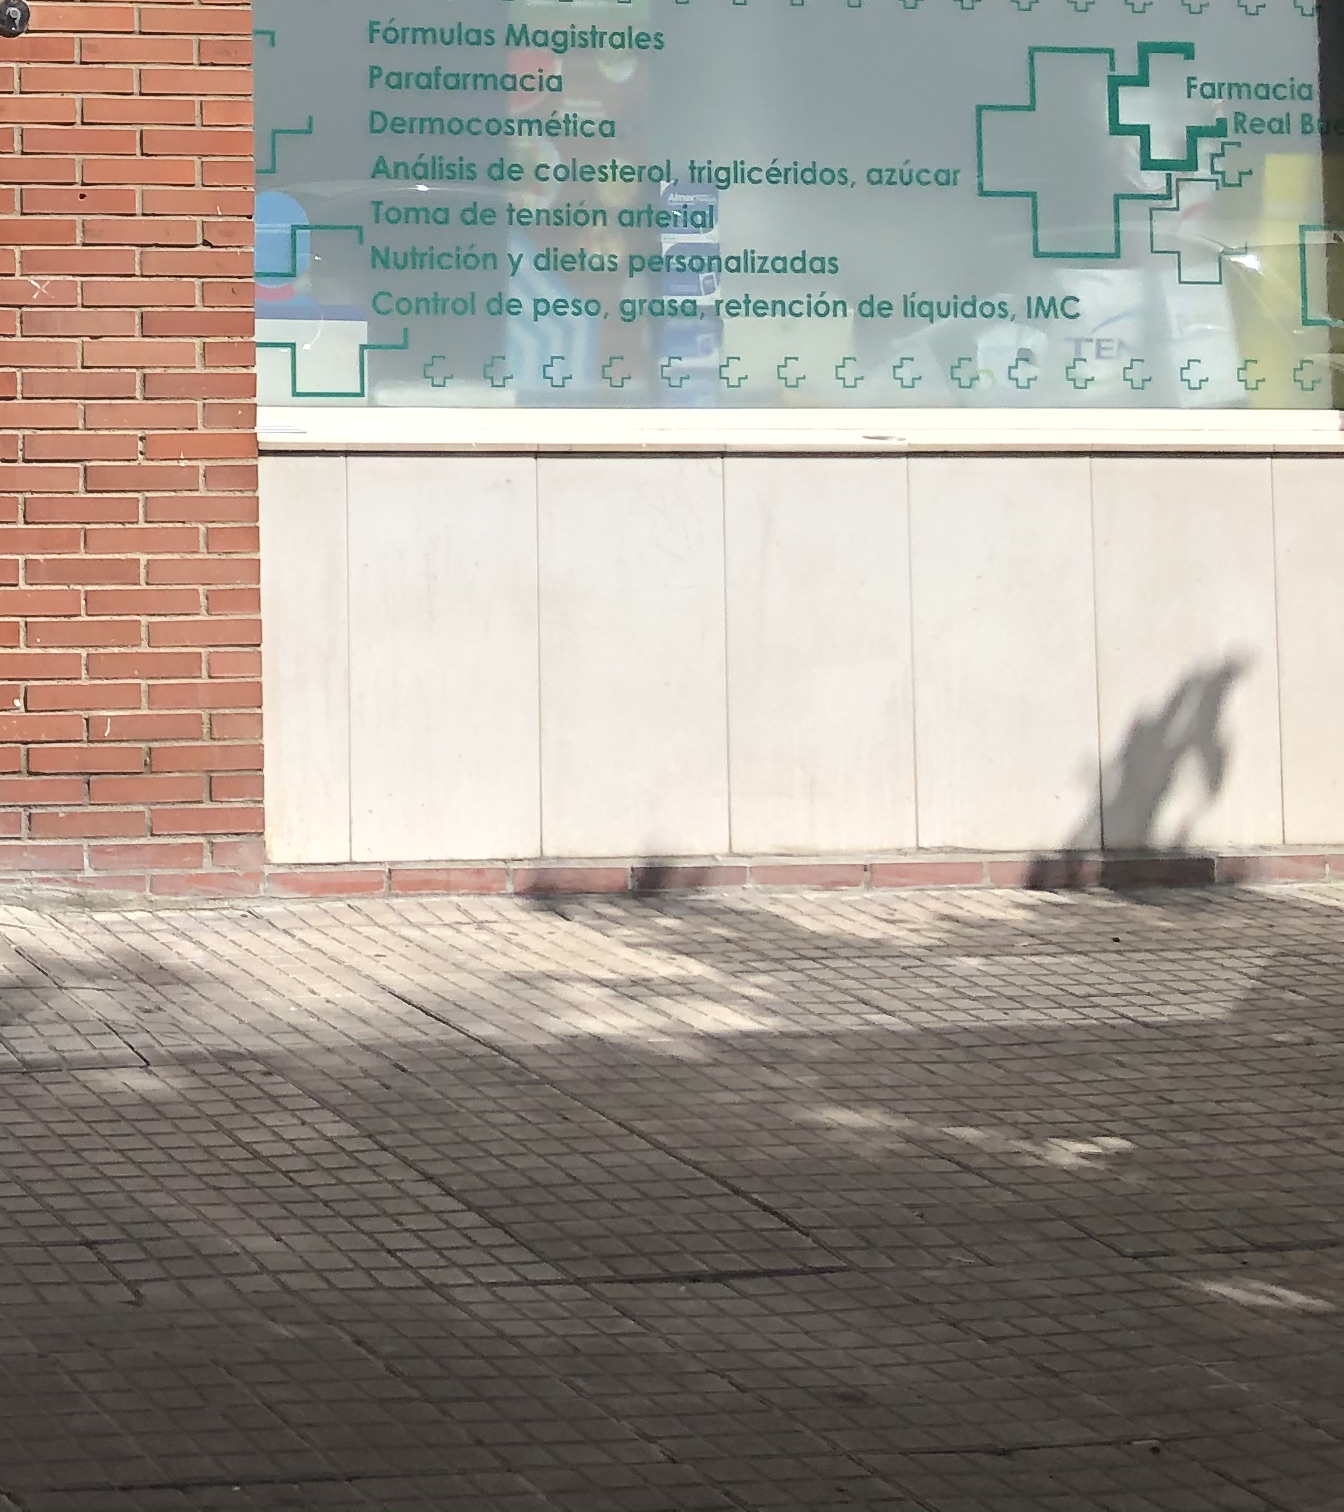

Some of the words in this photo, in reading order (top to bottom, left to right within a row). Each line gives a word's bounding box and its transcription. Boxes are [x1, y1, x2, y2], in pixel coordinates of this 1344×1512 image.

[368, 18, 496, 48] Fórmulas
[504, 22, 666, 55] Magistrales
[368, 65, 564, 93] Parafarmacia
[1186, 75, 1313, 102] Farmacia
[368, 109, 616, 139] Dermocosmética
[1233, 111, 1291, 135] Real
[370, 152, 477, 182] Análisis
[487, 156, 525, 183] de
[533, 156, 679, 186] colesterol,
[688, 159, 856, 191] triglicéridos,
[866, 158, 961, 188] azúcar
[370, 201, 450, 226] Toma
[461, 200, 498, 227] de
[507, 201, 608, 228] tensión
[617, 203, 715, 230] arterial
[370, 243, 498, 273] Nutrición
[507, 252, 524, 277] y
[533, 246, 619, 275] dietas
[628, 248, 840, 279] personalizadas
[371, 290, 476, 318] Control
[487, 292, 524, 318] de
[532, 298, 610, 325] peso,
[619, 298, 706, 324] grasa,
[714, 291, 848, 320] retención
[858, 292, 895, 320] de
[903, 291, 1017, 325] líquidos,
[1026, 294, 1082, 321] IMC
